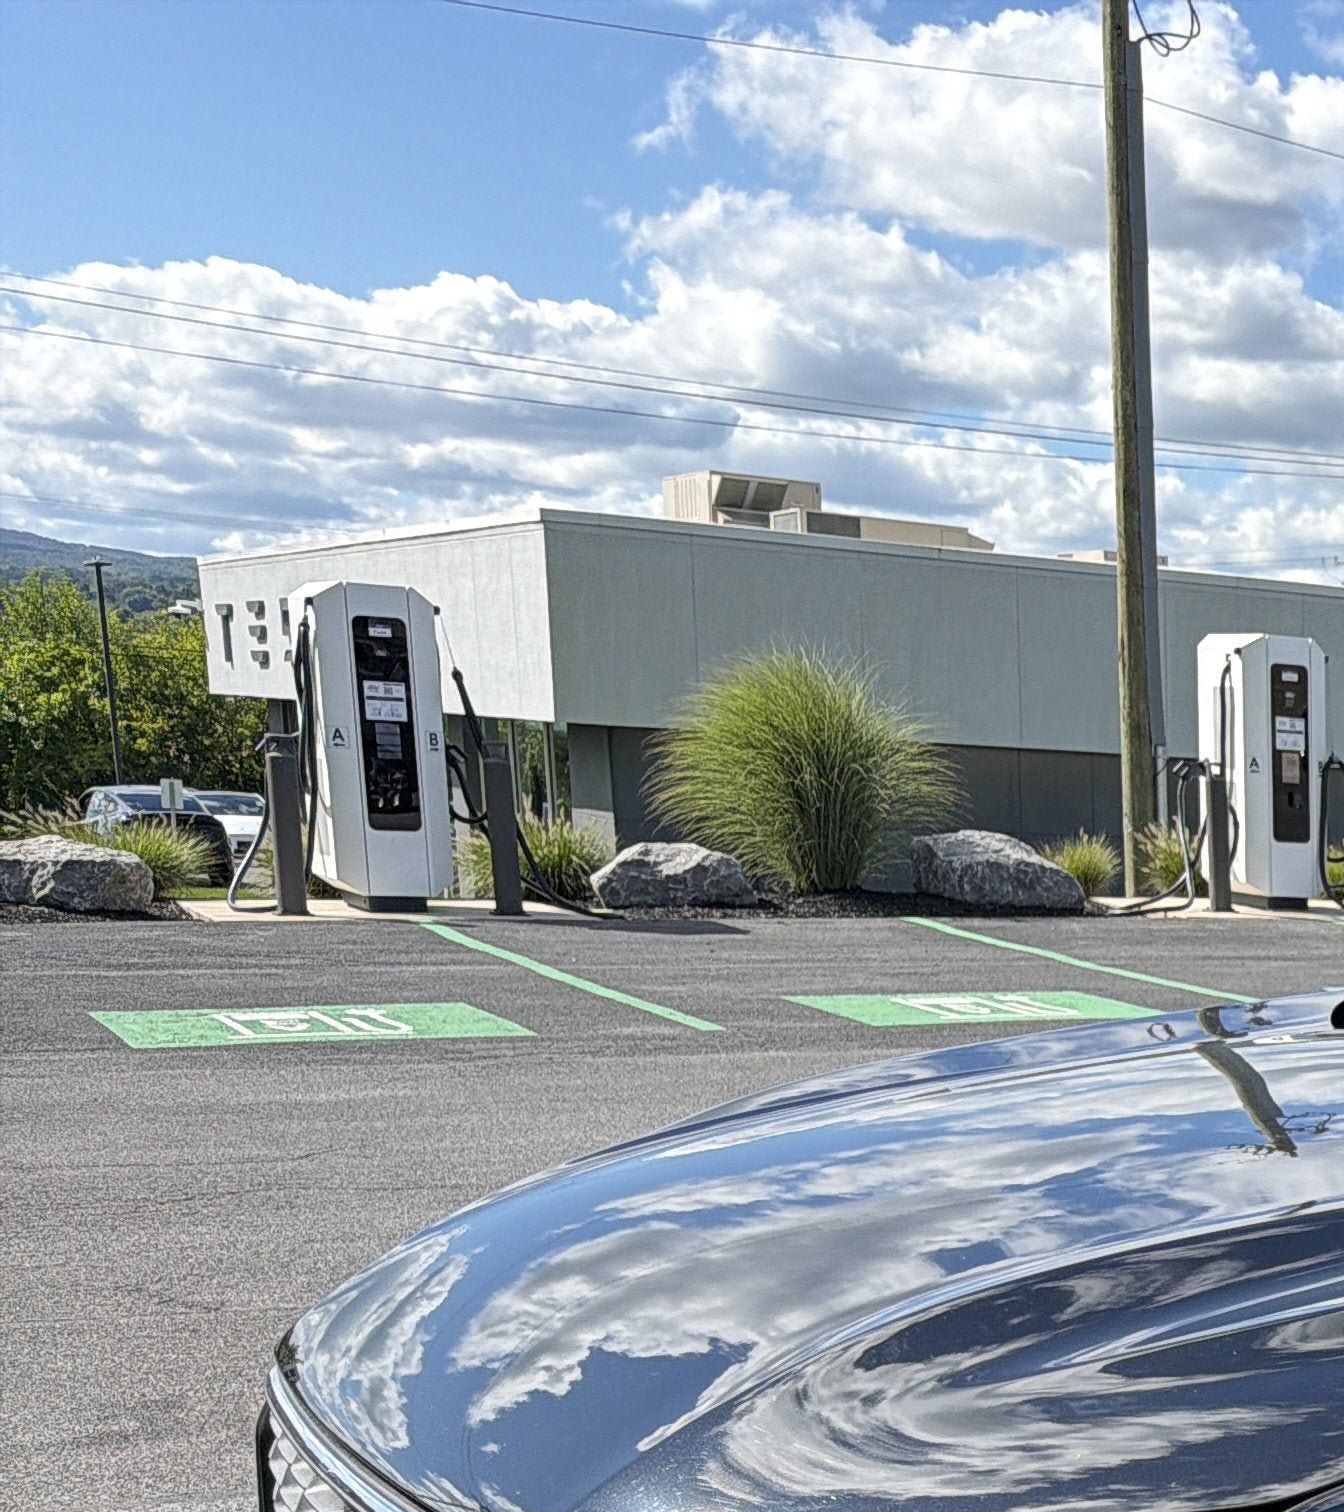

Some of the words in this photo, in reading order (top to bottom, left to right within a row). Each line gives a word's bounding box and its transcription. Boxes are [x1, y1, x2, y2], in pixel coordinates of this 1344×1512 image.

[332, 727, 345, 742] A
[429, 732, 439, 747] B
[1249, 757, 1260, 769] A
